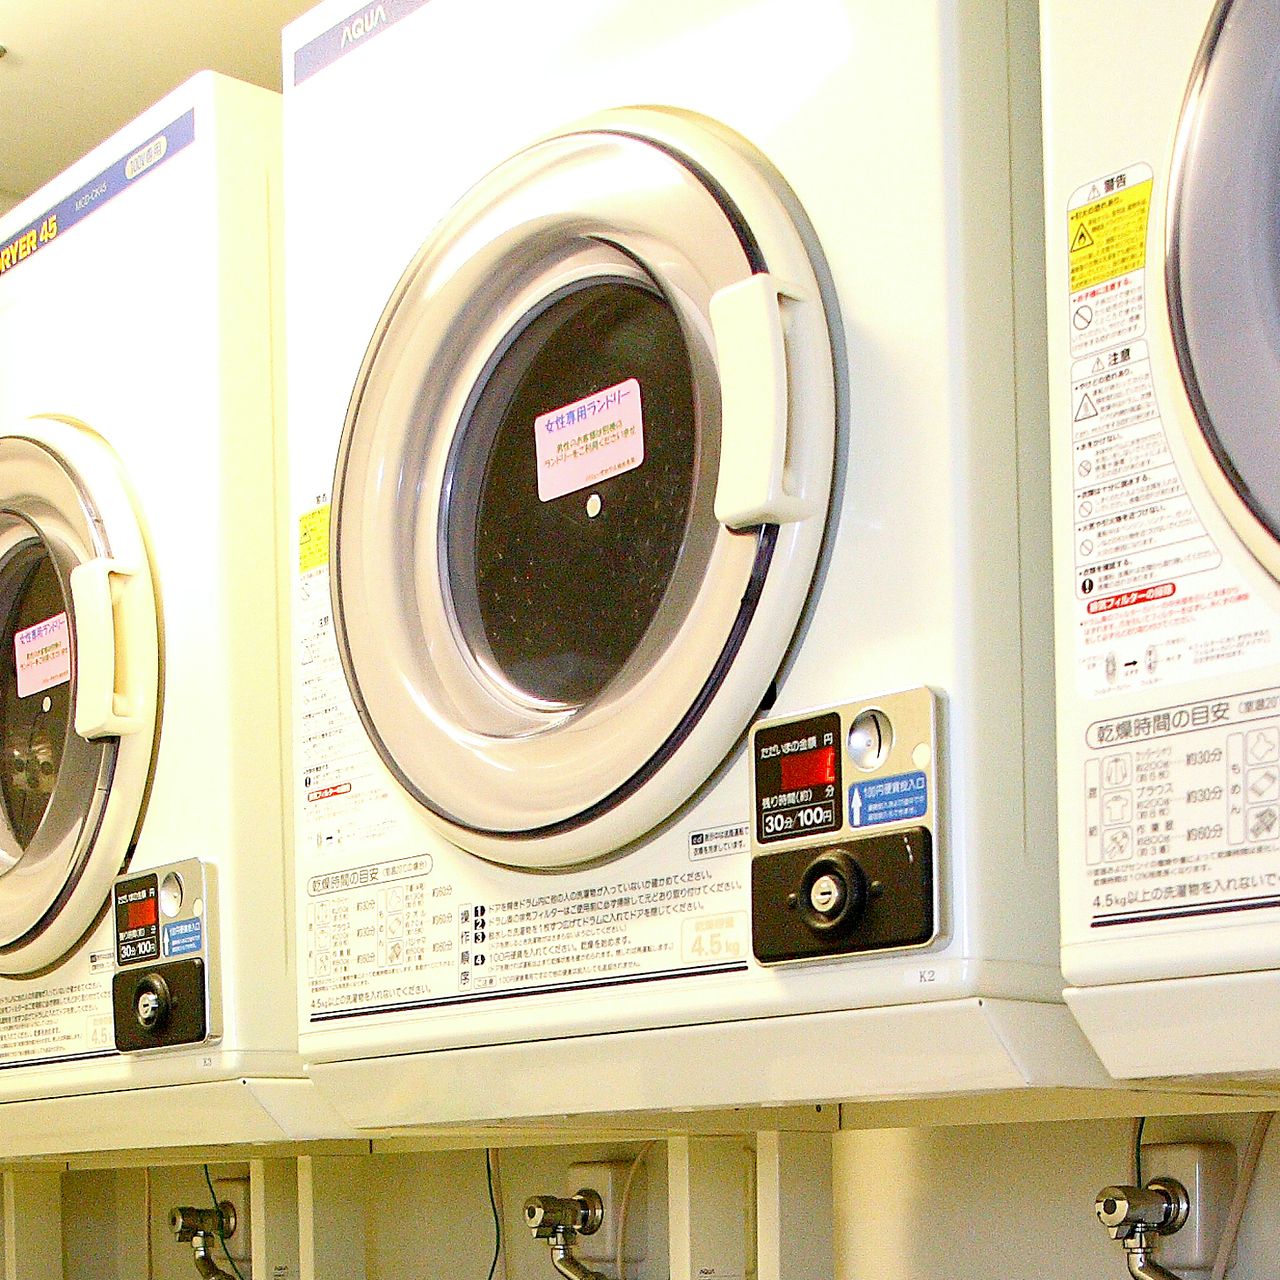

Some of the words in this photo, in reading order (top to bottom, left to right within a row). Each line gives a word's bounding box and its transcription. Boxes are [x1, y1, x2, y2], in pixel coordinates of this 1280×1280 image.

[341, 5, 389, 48] AQUA
[39, 215, 58, 243] 45
[1108, 348, 1131, 366] 注意
[545, 389, 631, 434] 女性専用ランドリー
[1097, 702, 1231, 743] 乾燥時間の目安
[761, 736, 816, 759] ただいまの金額
[823, 732, 833, 745] 円
[825, 785, 835, 799] 分
[312, 868, 380, 893] 乾燥時間の目安
[692, 934, 741, 956] 4.5kg
[919, 970, 936, 983] K2
